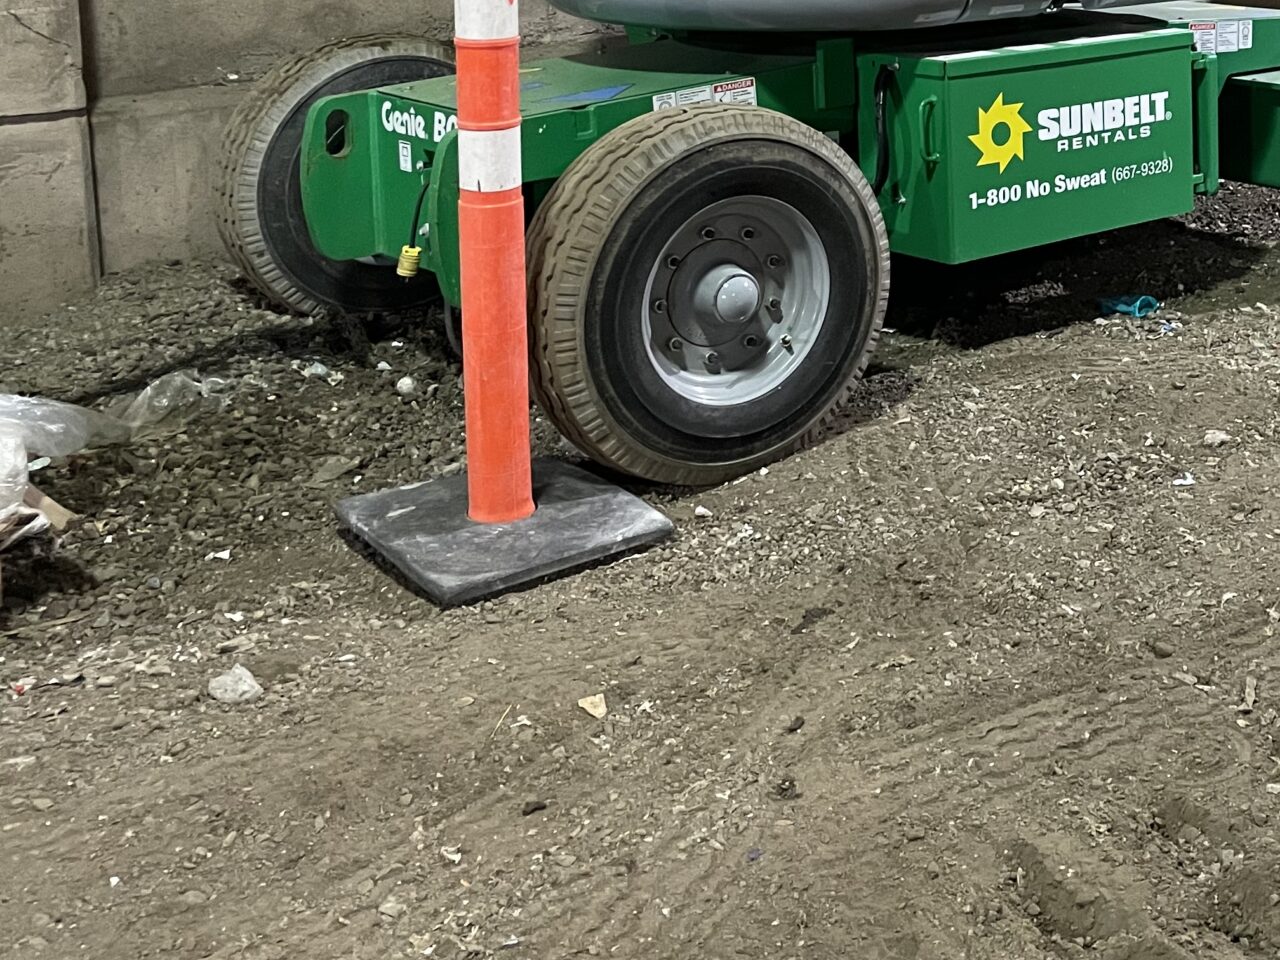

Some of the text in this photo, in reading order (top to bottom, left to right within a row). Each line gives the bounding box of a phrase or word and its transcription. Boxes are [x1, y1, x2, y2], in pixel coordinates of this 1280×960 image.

[721, 80, 752, 92] DANGER
[381, 100, 426, 139] Genie
[1037, 91, 1169, 141] SUNBELT
[1057, 125, 1152, 153] RENTALS
[968, 157, 1173, 210] 1-800 No Sweat (667-9328)
